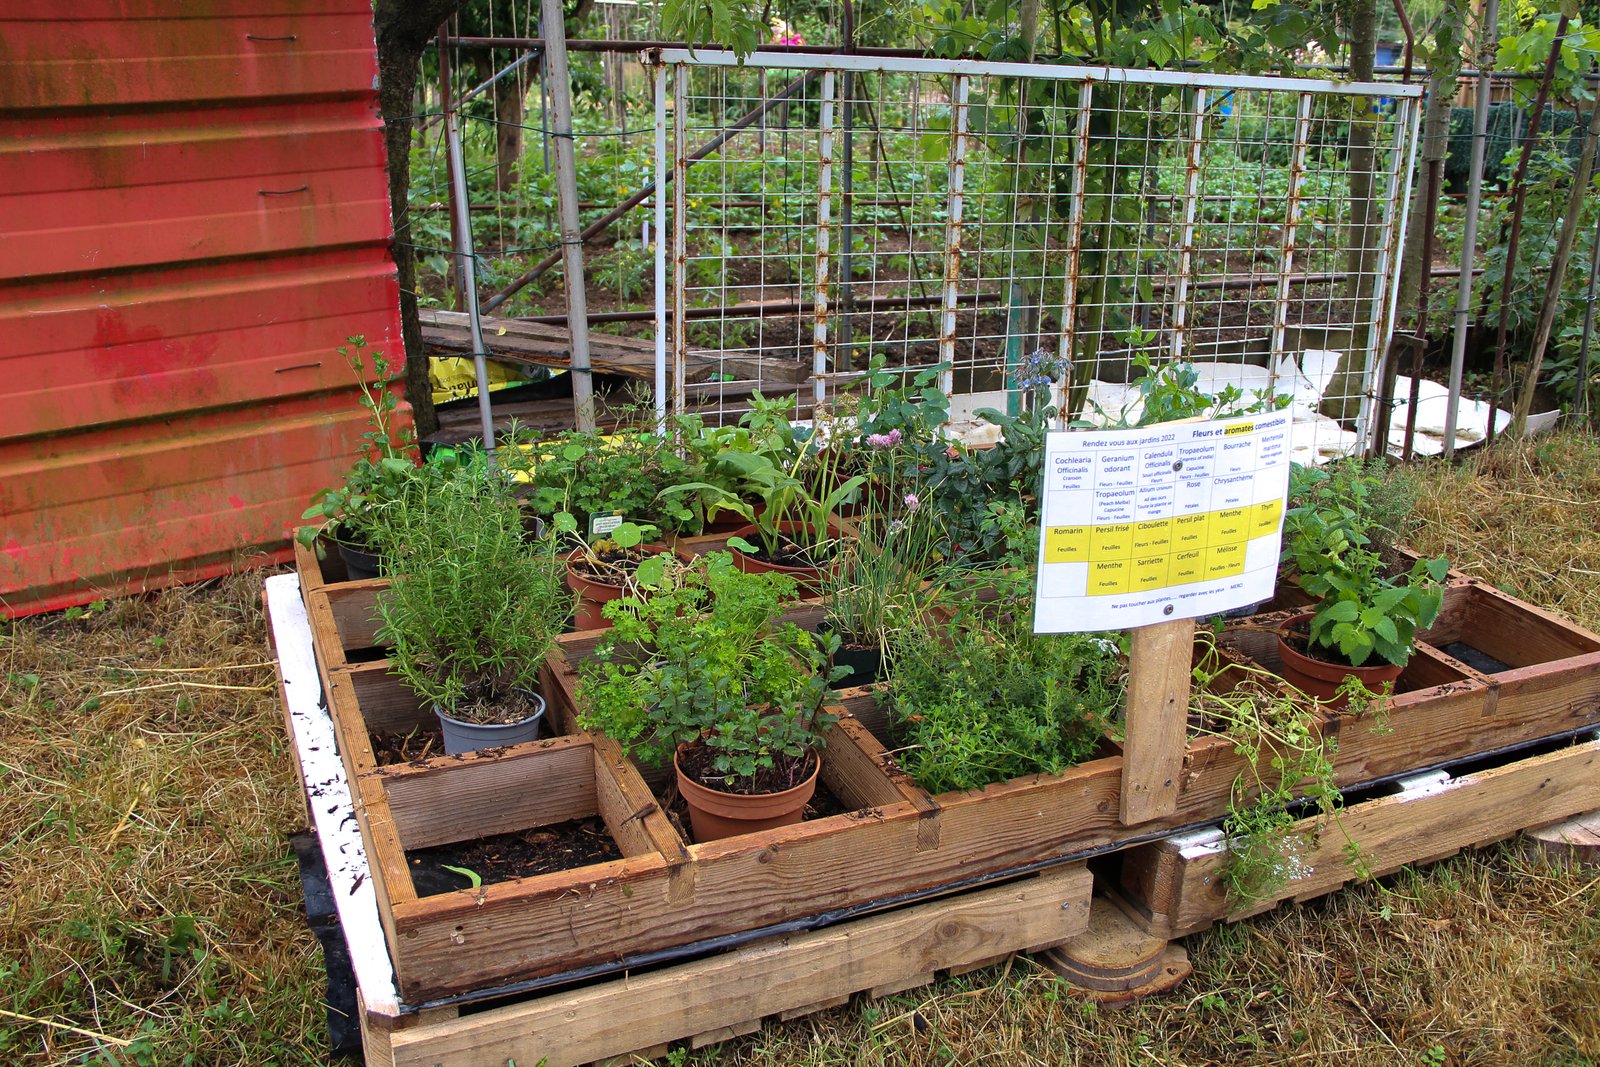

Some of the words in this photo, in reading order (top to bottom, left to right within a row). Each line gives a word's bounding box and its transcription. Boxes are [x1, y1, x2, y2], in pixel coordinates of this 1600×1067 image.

[1192, 429, 1213, 438] Fleurs
[1224, 425, 1254, 434] aromates
[1255, 418, 1286, 430] comestibles
[1139, 436, 1160, 445] jardins
[1161, 433, 1175, 442] 2022
[1224, 441, 1251, 450] Bourrache
[1179, 446, 1214, 455] Tropaeolum
[1144, 451, 1173, 460] Calendula
[1096, 490, 1135, 498] Tropaeolum
[1220, 510, 1242, 518] Menthe
[1194, 515, 1205, 523] plat
[1138, 520, 1168, 530] Ciboulette
[1217, 545, 1237, 554] Mélisse
[1177, 551, 1199, 561] Cerfeuil
[1138, 558, 1163, 566] Sarriette
